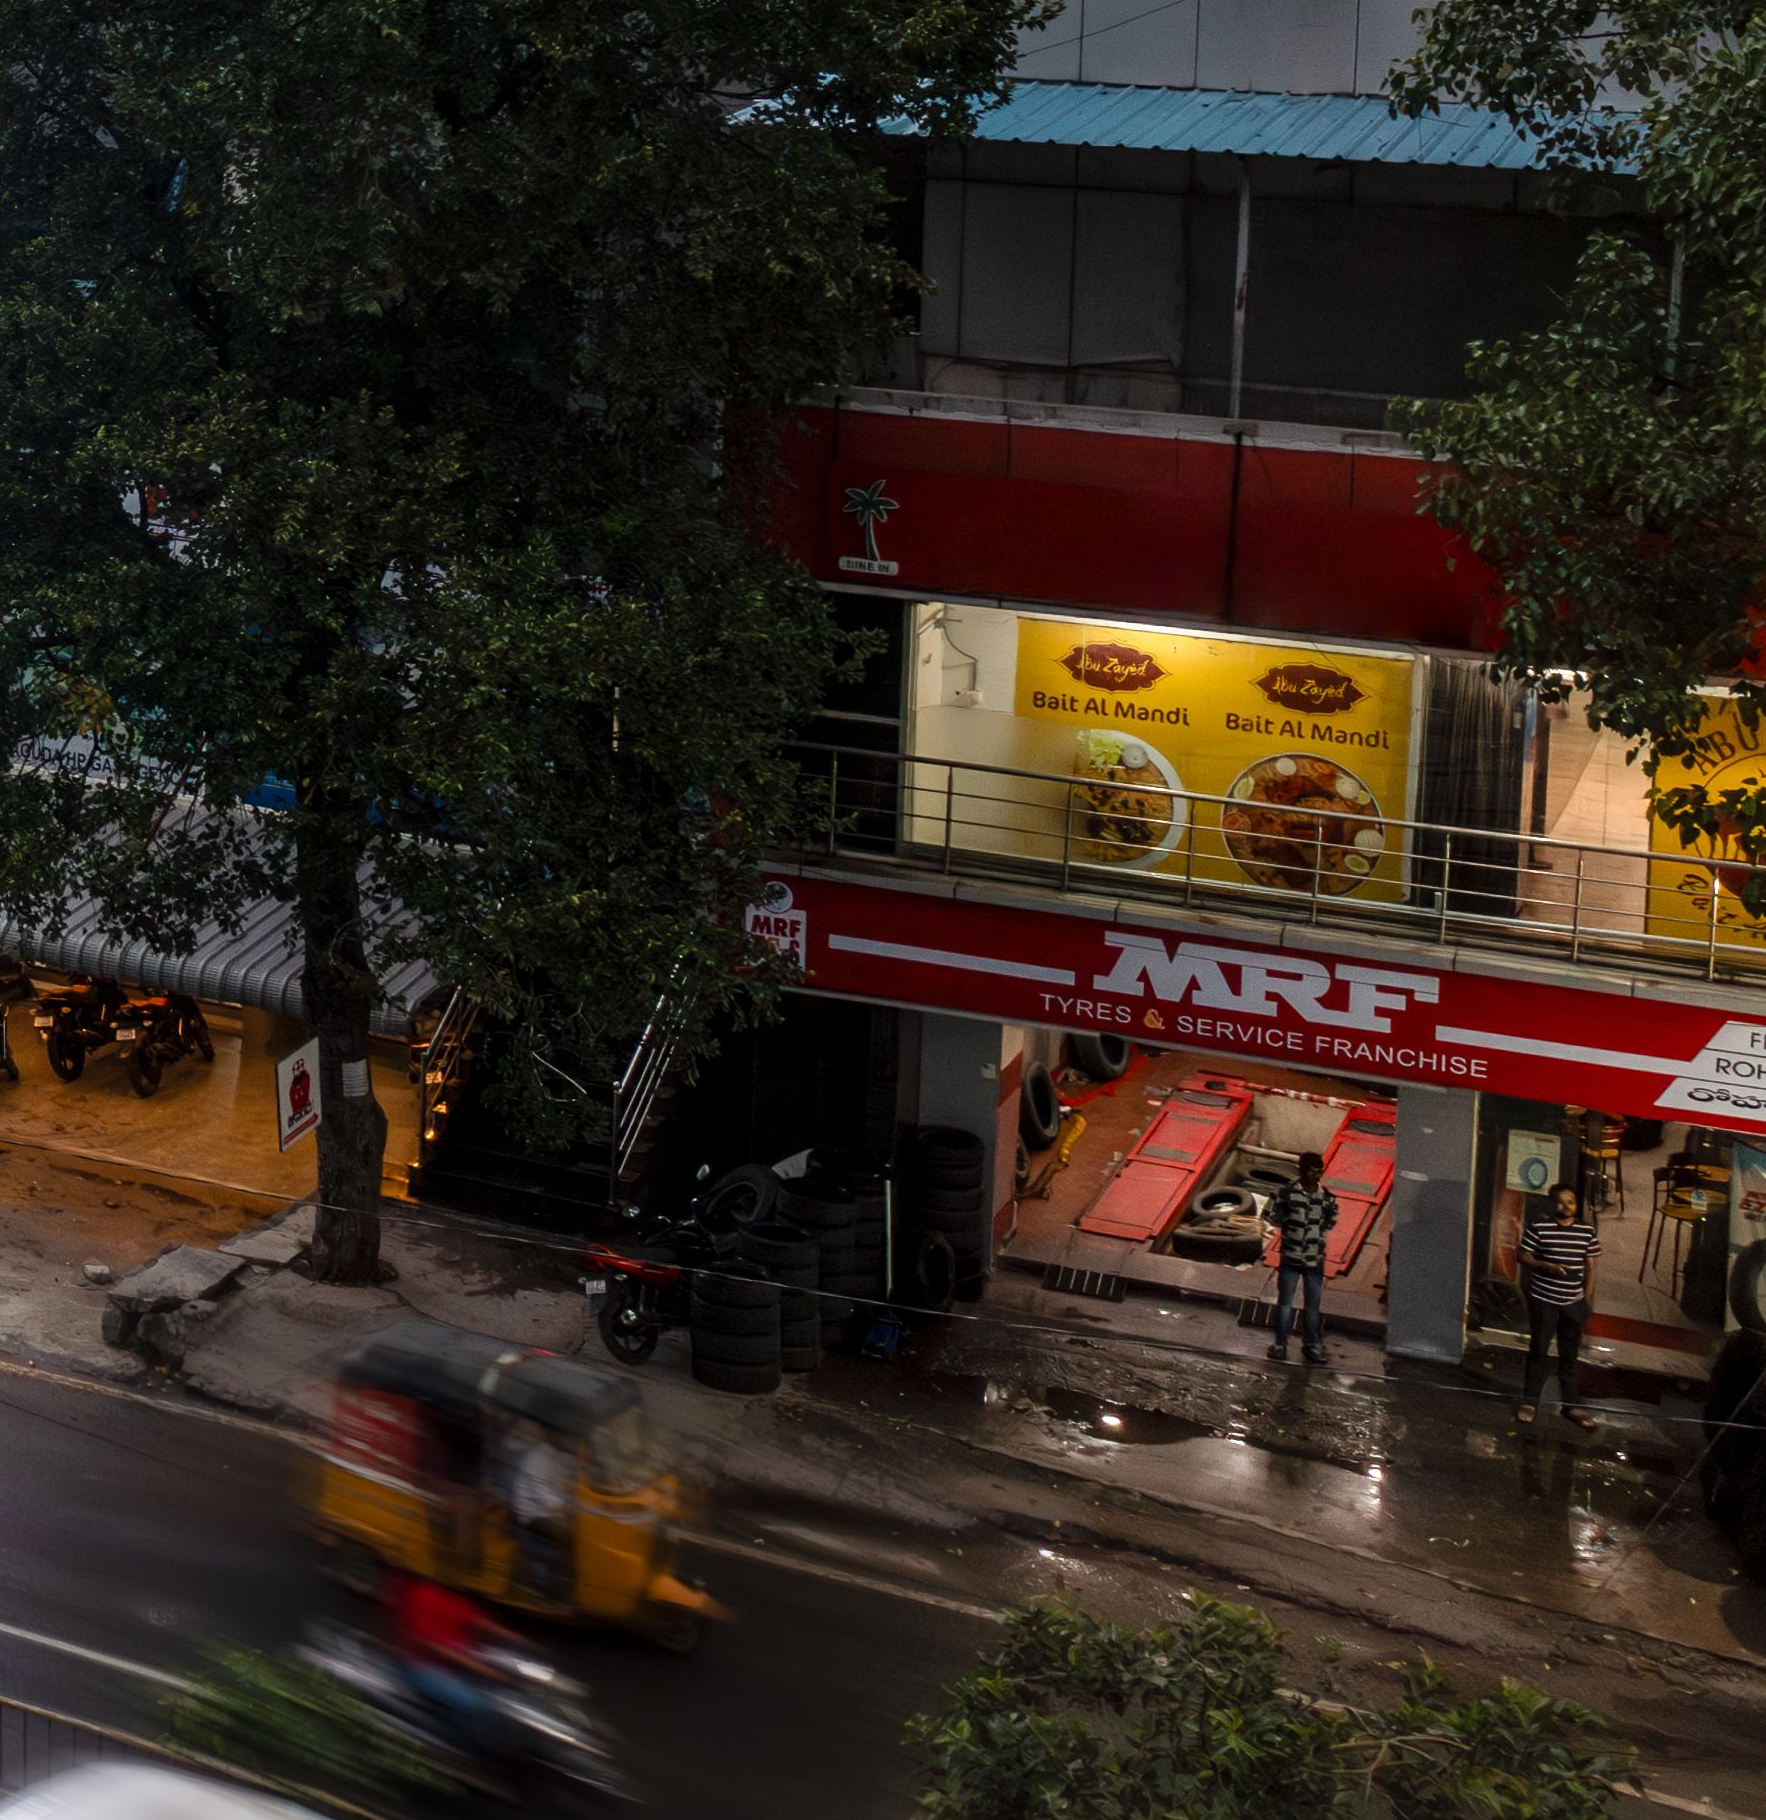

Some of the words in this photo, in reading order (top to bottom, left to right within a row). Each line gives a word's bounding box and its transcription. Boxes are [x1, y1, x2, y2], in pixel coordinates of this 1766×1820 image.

[1032, 691, 1079, 712] Bait
[1084, 698, 1109, 716] Al
[1114, 702, 1190, 726] Mandi
[1225, 713, 1274, 735] Bait
[1279, 720, 1304, 739] Al
[1309, 724, 1390, 750] Mandi
[751, 914, 802, 938] MRF
[1093, 930, 1440, 1033] MRF
[1039, 993, 1131, 1025] TYRES
[1142, 1008, 1166, 1030] &
[1176, 1015, 1304, 1052] SERVICE
[1315, 1035, 1489, 1079] FRANCHISE
[1750, 1031, 1766, 1050] F
